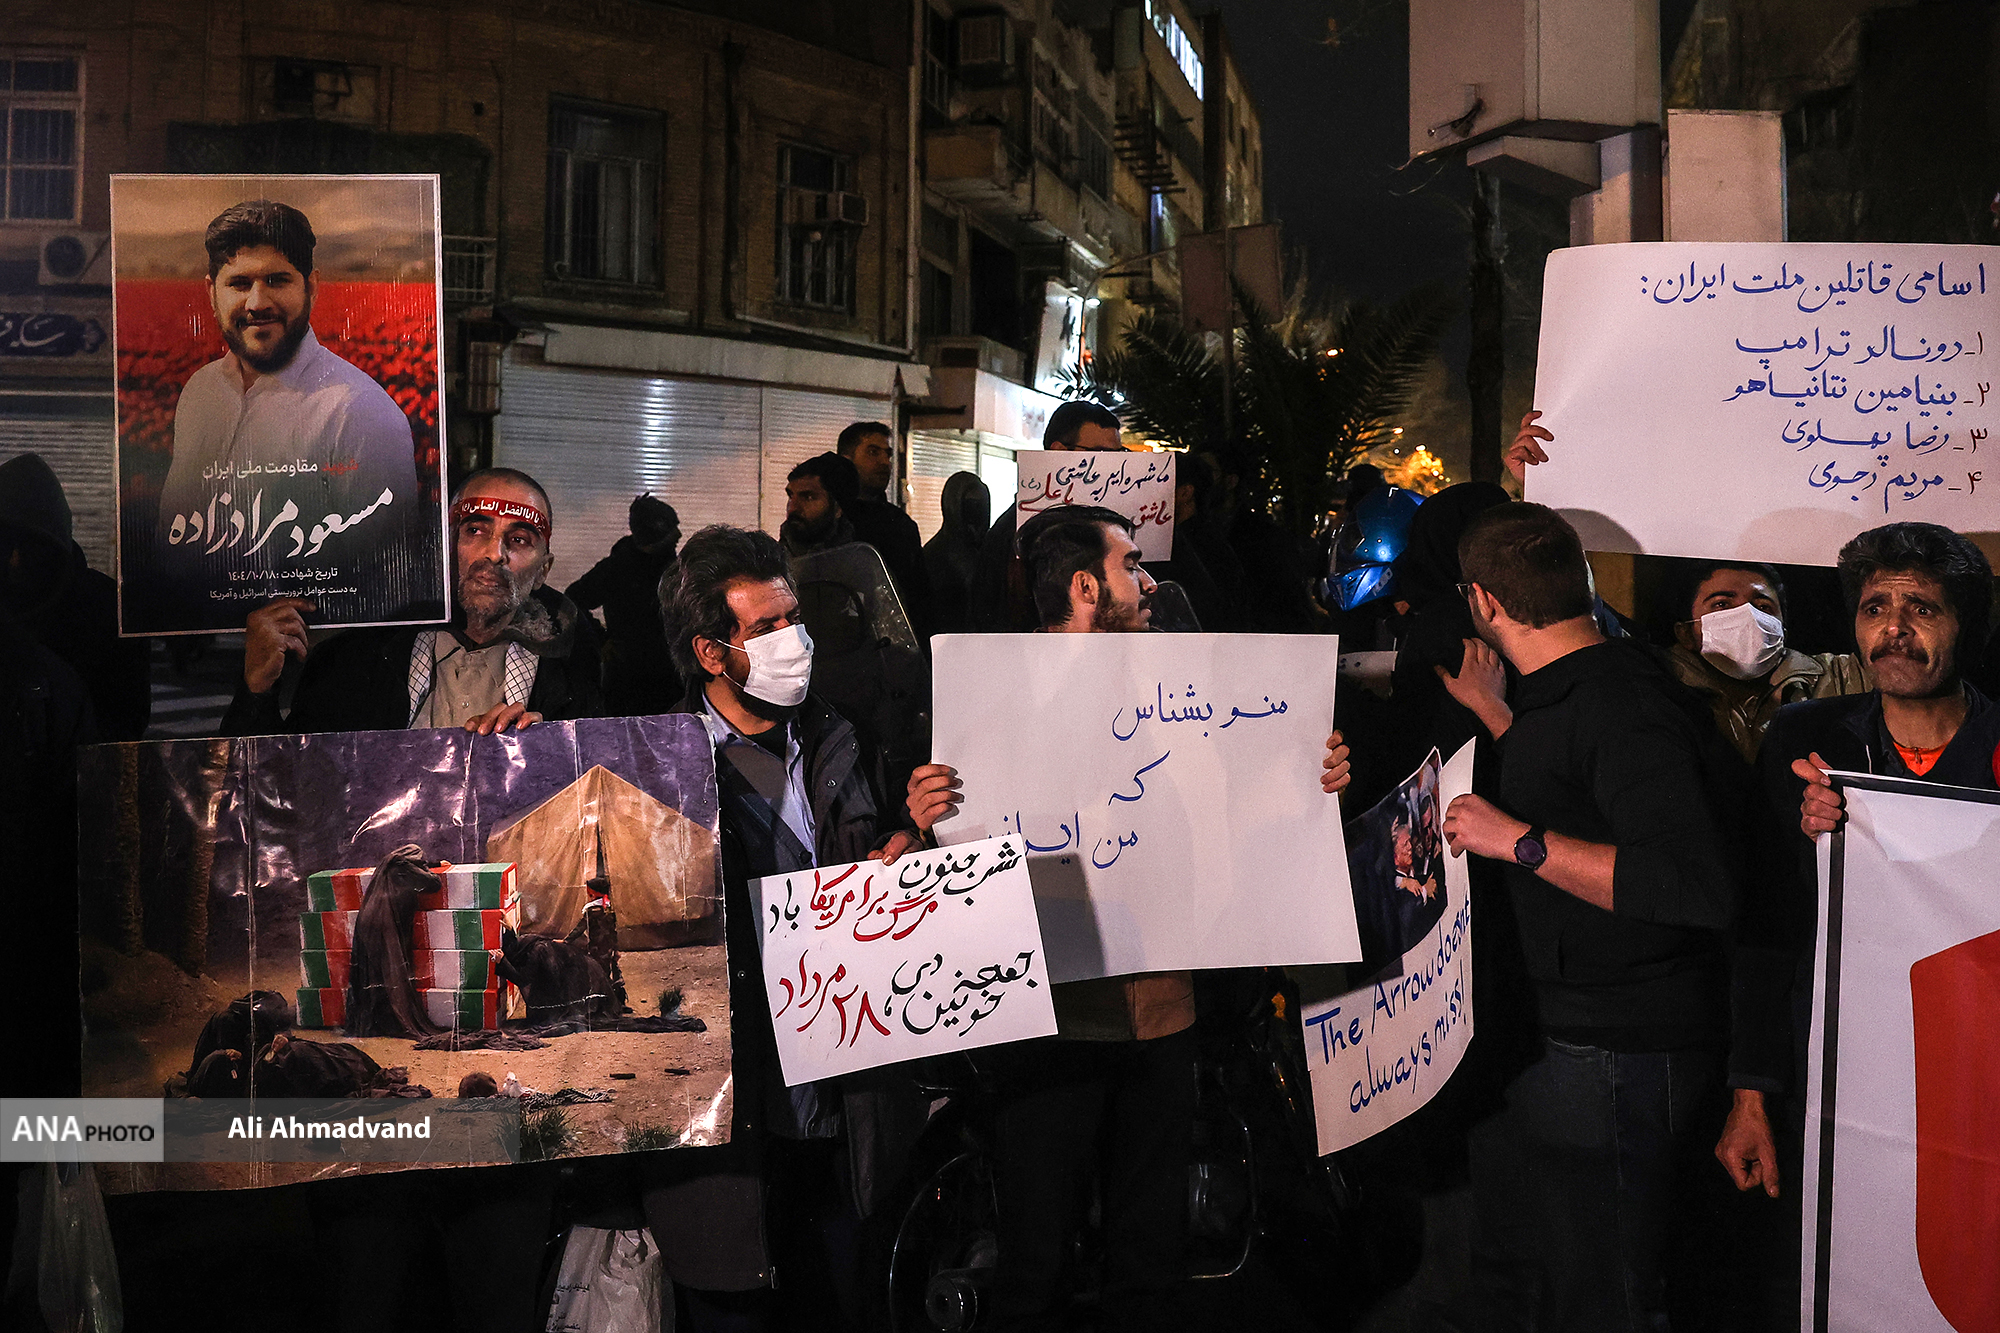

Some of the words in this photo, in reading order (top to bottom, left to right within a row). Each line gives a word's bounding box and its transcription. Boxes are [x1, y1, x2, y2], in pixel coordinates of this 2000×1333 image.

[1732, 261, 1804, 294] ملت
[1797, 260, 1892, 313] قاتلین
[1895, 262, 1987, 304] اسامی
[1735, 327, 1852, 370] ترامپ
[1722, 370, 1848, 408] نتانیاهو
[1853, 373, 1957, 417] بنیامین
[1781, 417, 1892, 468] پهلوی
[1904, 421, 1950, 456] رضا
[202, 460, 234, 480] ایران
[236, 459, 262, 479] ملی
[265, 458, 318, 476] مقاومت
[322, 457, 359, 475] شهید
[1157, 455, 1172, 483] ما
[1808, 459, 1877, 501] رجوی
[1090, 486, 1104, 502] به
[1883, 470, 1944, 513] مریم
[168, 488, 299, 558] مرادزاده
[286, 487, 394, 559] مسعود
[209, 588, 233, 601] آمریکا
[239, 588, 267, 599] اسرائیل
[267, 588, 303, 598] تروریستی
[303, 586, 327, 596] عوامل
[315, 567, 338, 581] تاریخ
[328, 586, 348, 594] دست
[349, 587, 357, 595] به
[1112, 682, 1214, 741] بشناس
[1219, 695, 1289, 729] منو
[1108, 750, 1171, 806] که
[987, 811, 1081, 865] ایران
[1092, 828, 1139, 869] من
[942, 841, 1022, 907] شب
[769, 878, 802, 934] باد
[852, 889, 939, 942] مرگ
[775, 949, 847, 1033] مرداد
[902, 970, 1006, 1038] خونین
[1305, 1007, 1364, 1065] The
[1371, 958, 1434, 1035] Arrow
[832, 984, 892, 1050] ۲۸
[1349, 1032, 1432, 1114] always
[1434, 958, 1467, 1051] miss!
